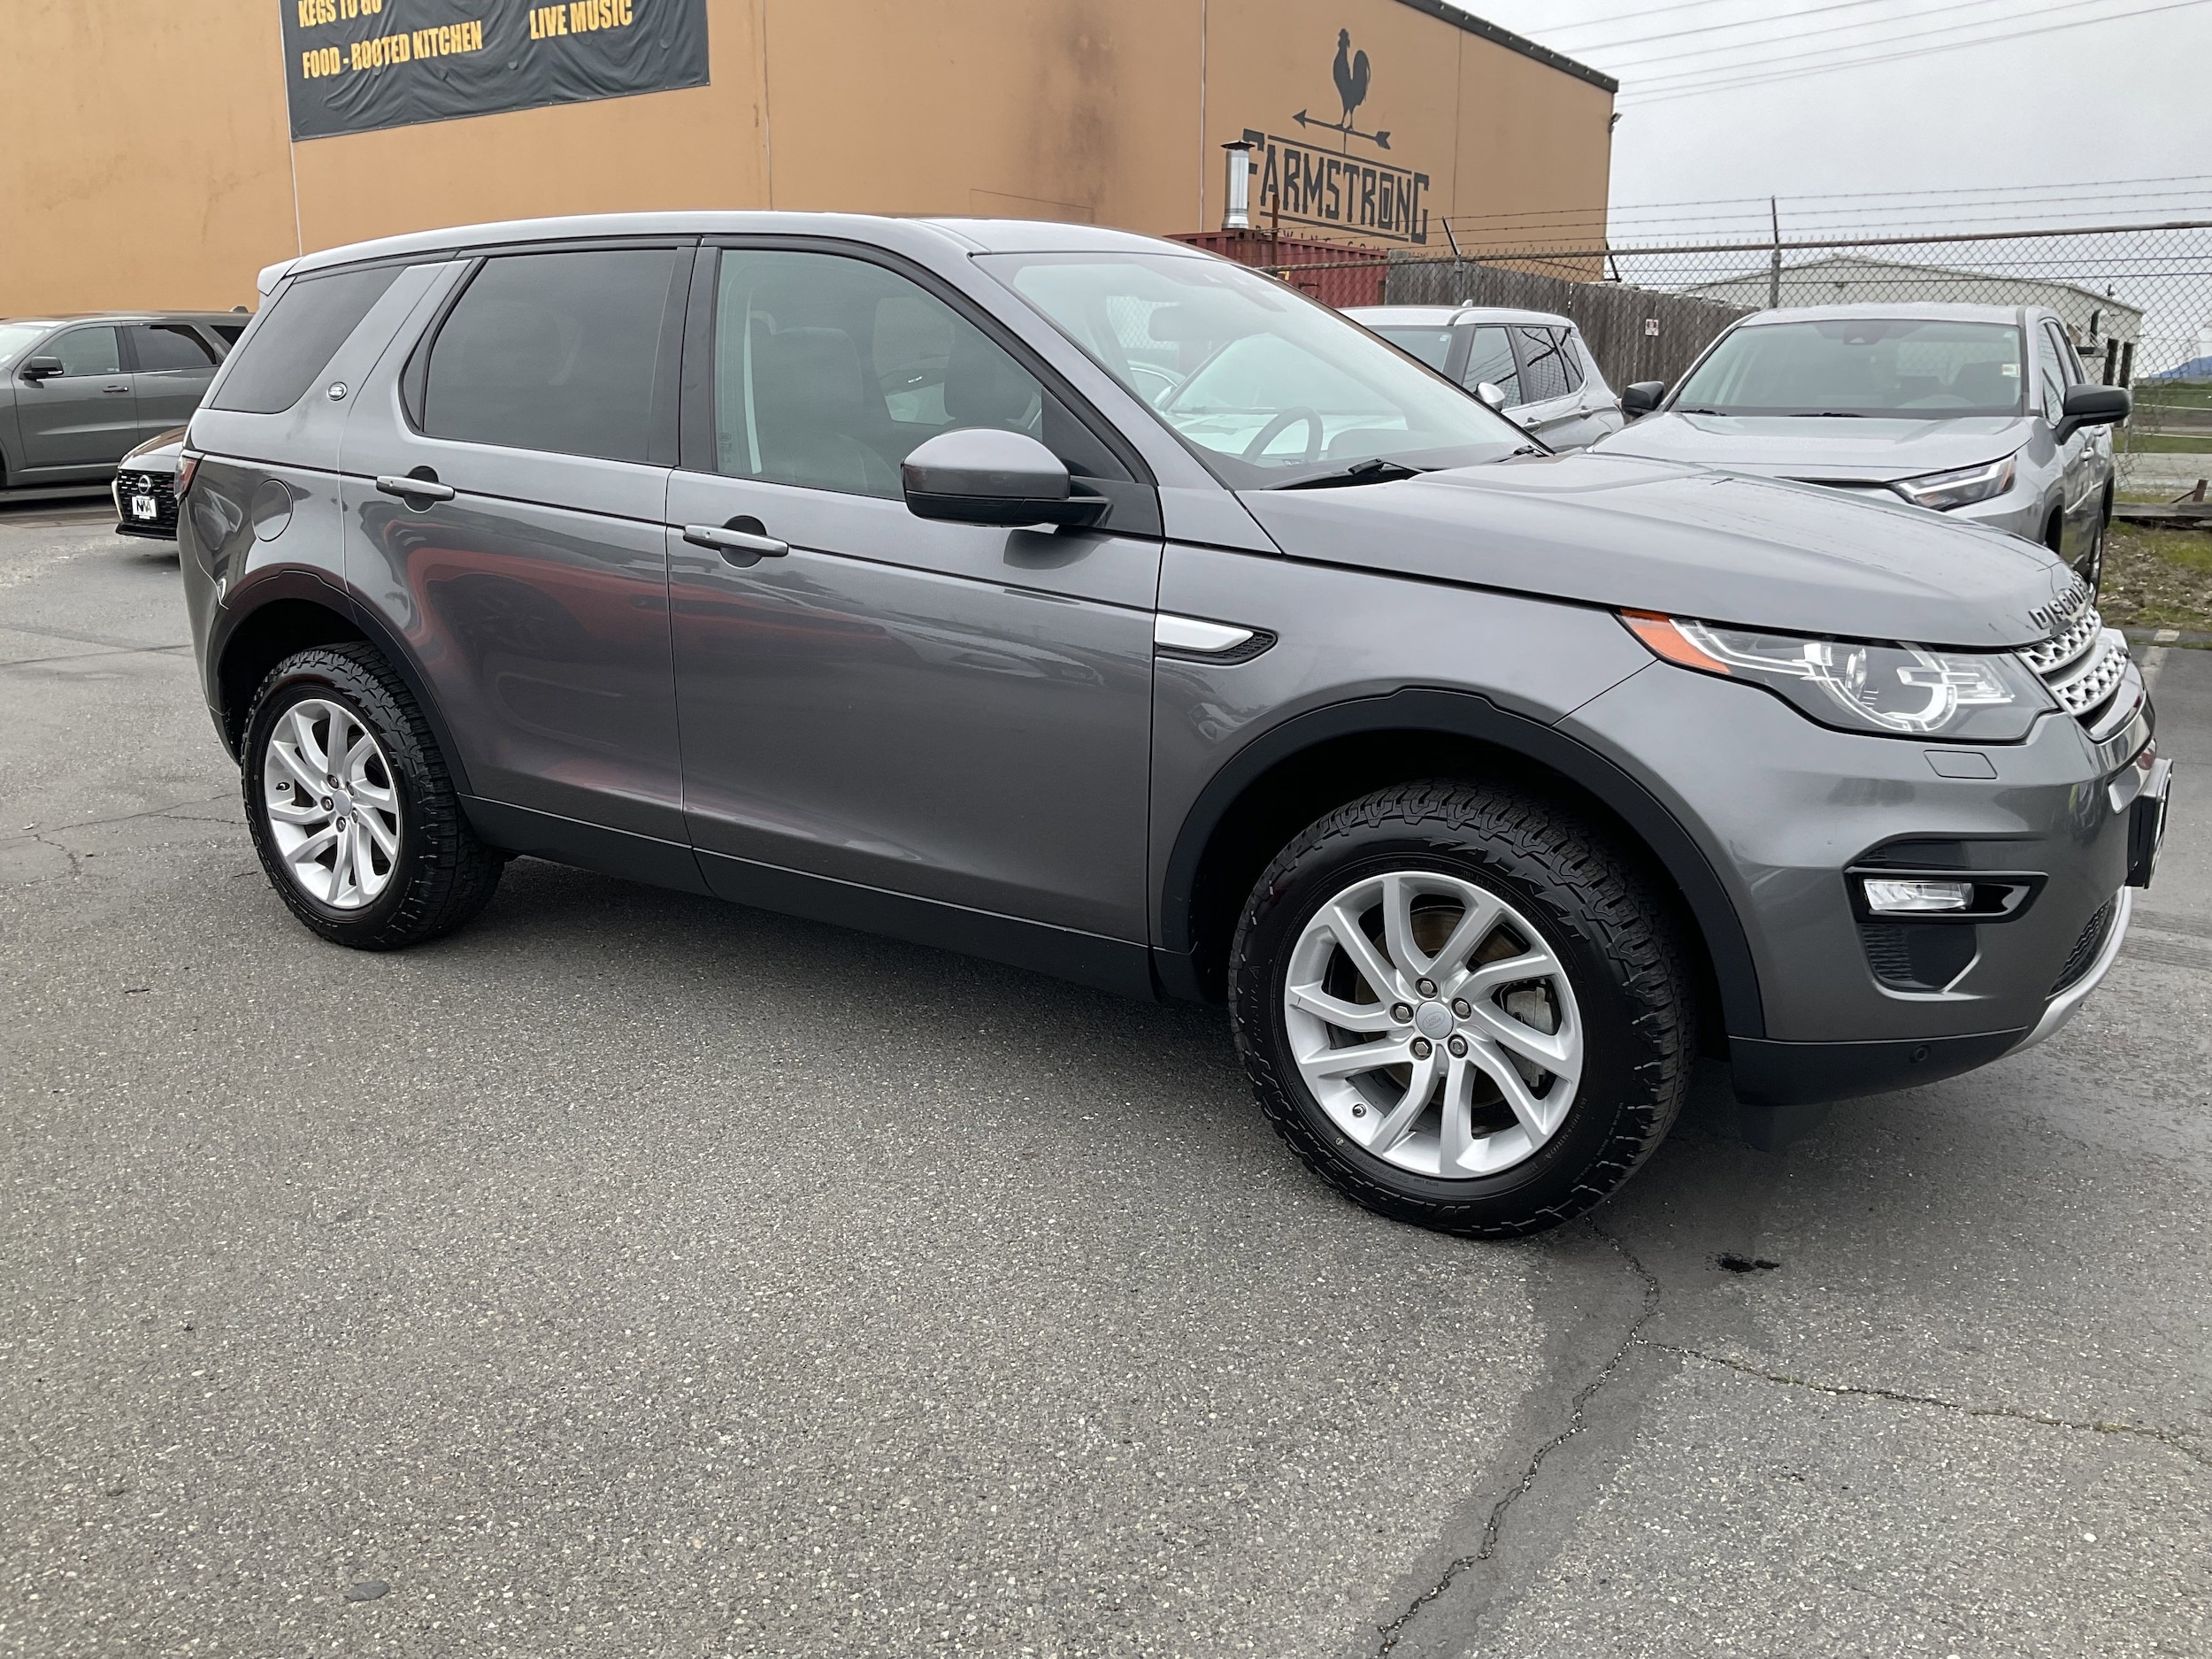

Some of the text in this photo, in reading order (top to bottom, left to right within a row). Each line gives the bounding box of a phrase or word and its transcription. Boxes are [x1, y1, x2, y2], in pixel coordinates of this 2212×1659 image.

[297, 0, 337, 27] KEGS
[529, 0, 633, 40] LIVE MUSIC
[302, 47, 340, 79] FOOD
[350, 34, 411, 71] ROOTED
[411, 20, 483, 59] KITCHEN
